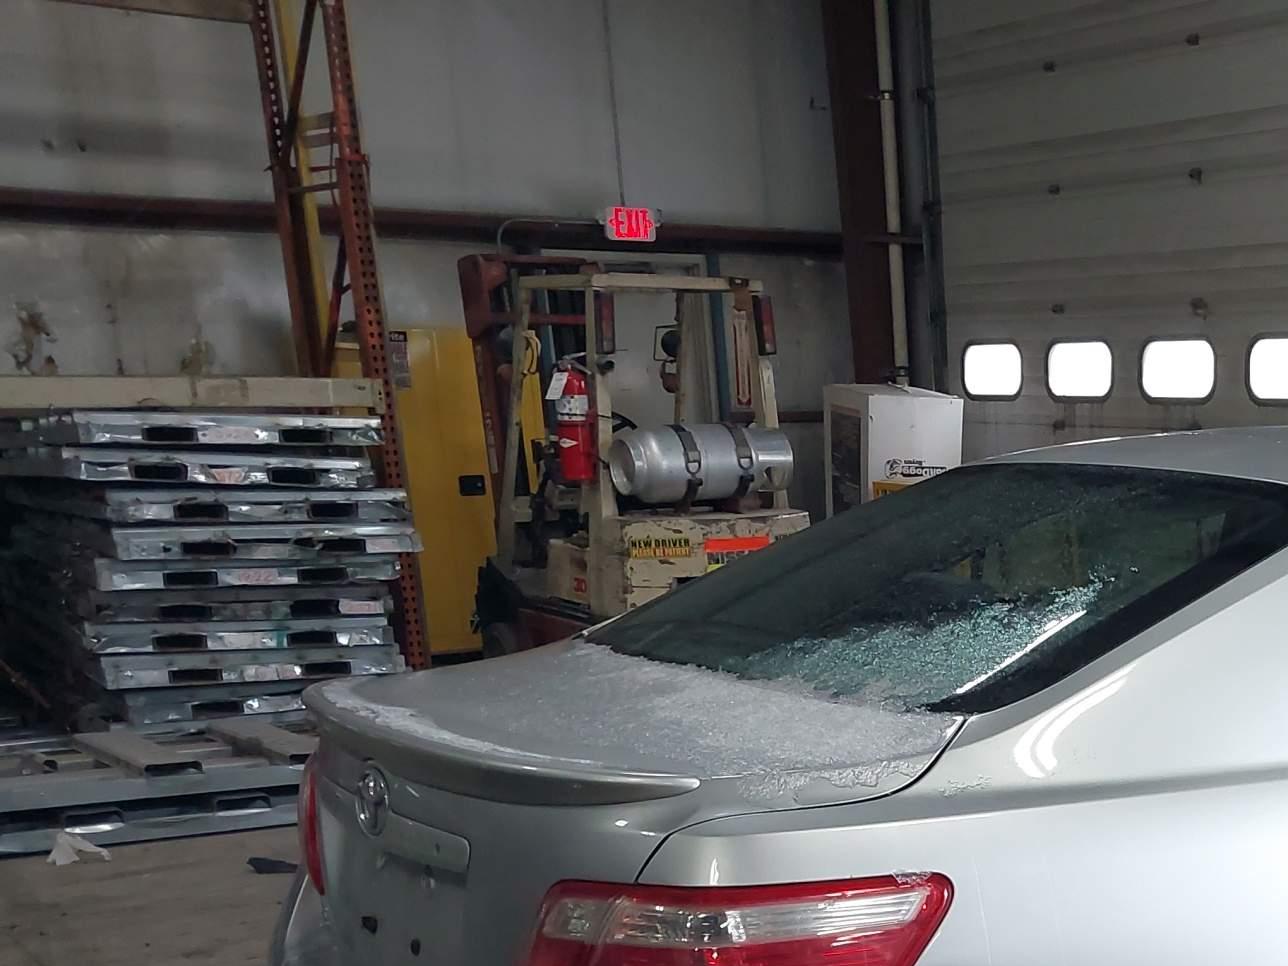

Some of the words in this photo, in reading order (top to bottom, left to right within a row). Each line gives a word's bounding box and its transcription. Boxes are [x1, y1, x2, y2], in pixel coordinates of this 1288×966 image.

[614, 207, 648, 239] EXIT
[631, 539, 652, 549] NEW
[654, 538, 690, 548] DRIVER
